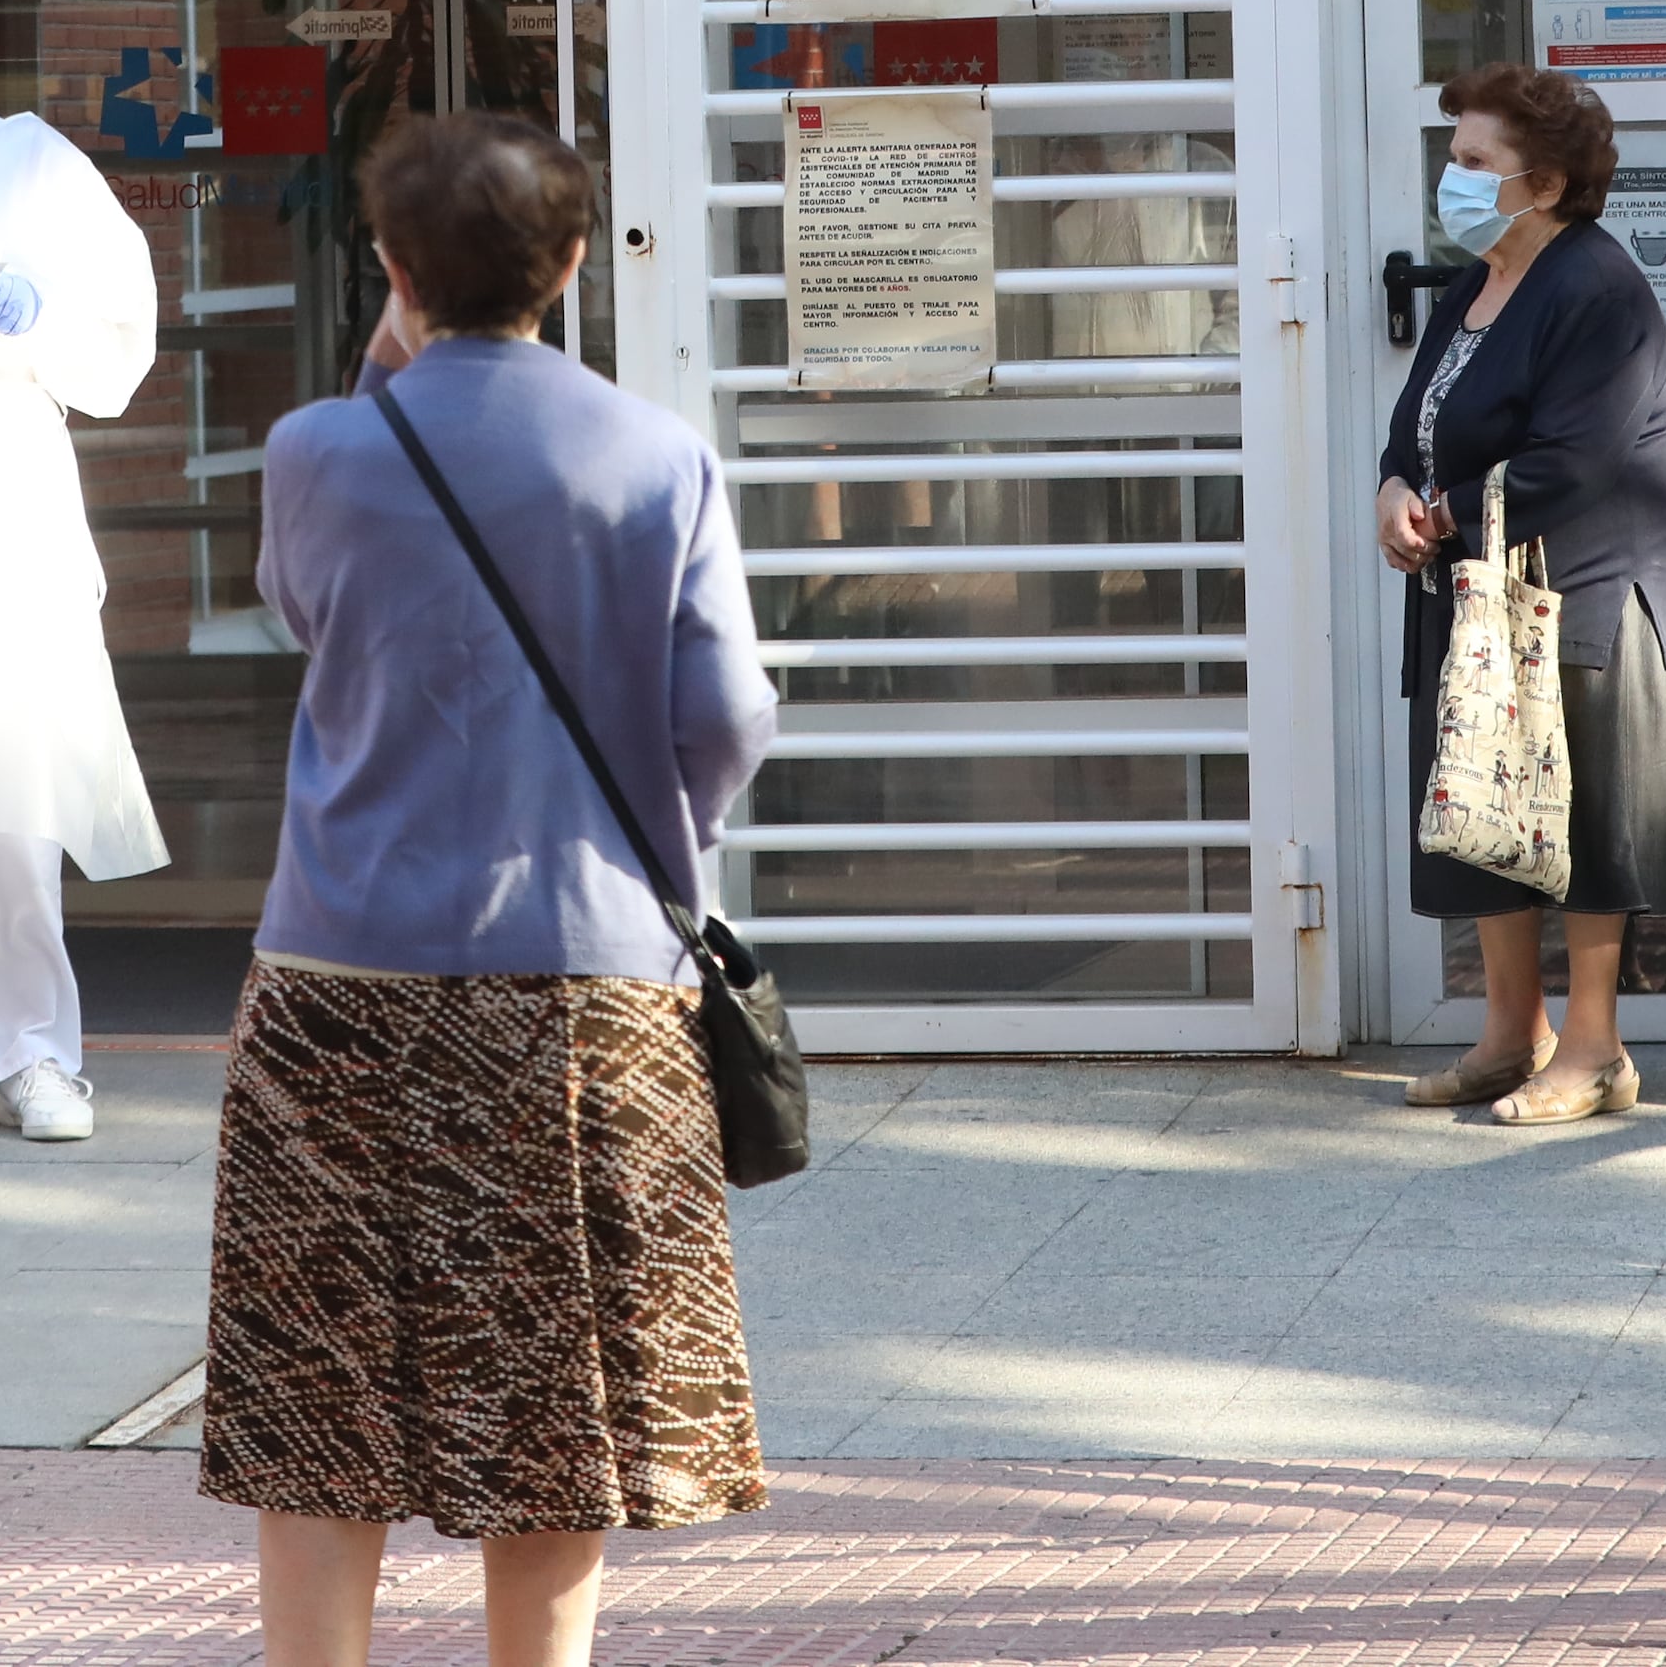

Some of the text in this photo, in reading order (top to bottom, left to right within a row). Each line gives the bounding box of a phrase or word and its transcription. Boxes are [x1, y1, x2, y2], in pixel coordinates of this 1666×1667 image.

[836, 145, 867, 153] ALERTA
[869, 144, 911, 152] SANITARIA
[800, 163, 862, 171] ASISTENCIALES
[879, 161, 920, 169] ATENCIÓN
[923, 160, 962, 168] PRIMARIA
[825, 171, 875, 179] COMUNIDAD
[1612, 172, 1637, 180] ENTA
[800, 181, 855, 189] ESTABLECIDO
[901, 177, 977, 186] EXTRAORDINARIAS
[873, 187, 928, 195] CIRCULACIÓN
[1625, 201, 1646, 209] UNA
[857, 223, 898, 231] GESTIONE
[947, 221, 977, 229] PREVIA
[823, 259, 864, 267] CIRCULAR
[852, 276, 903, 284] MASCARILLA
[886, 284, 911, 292] AÑOS.
[802, 302, 838, 310] DIRÍJASE
[842, 310, 898, 318] INFORMACIÓN
[1439, 762, 1484, 781] ndezvous
